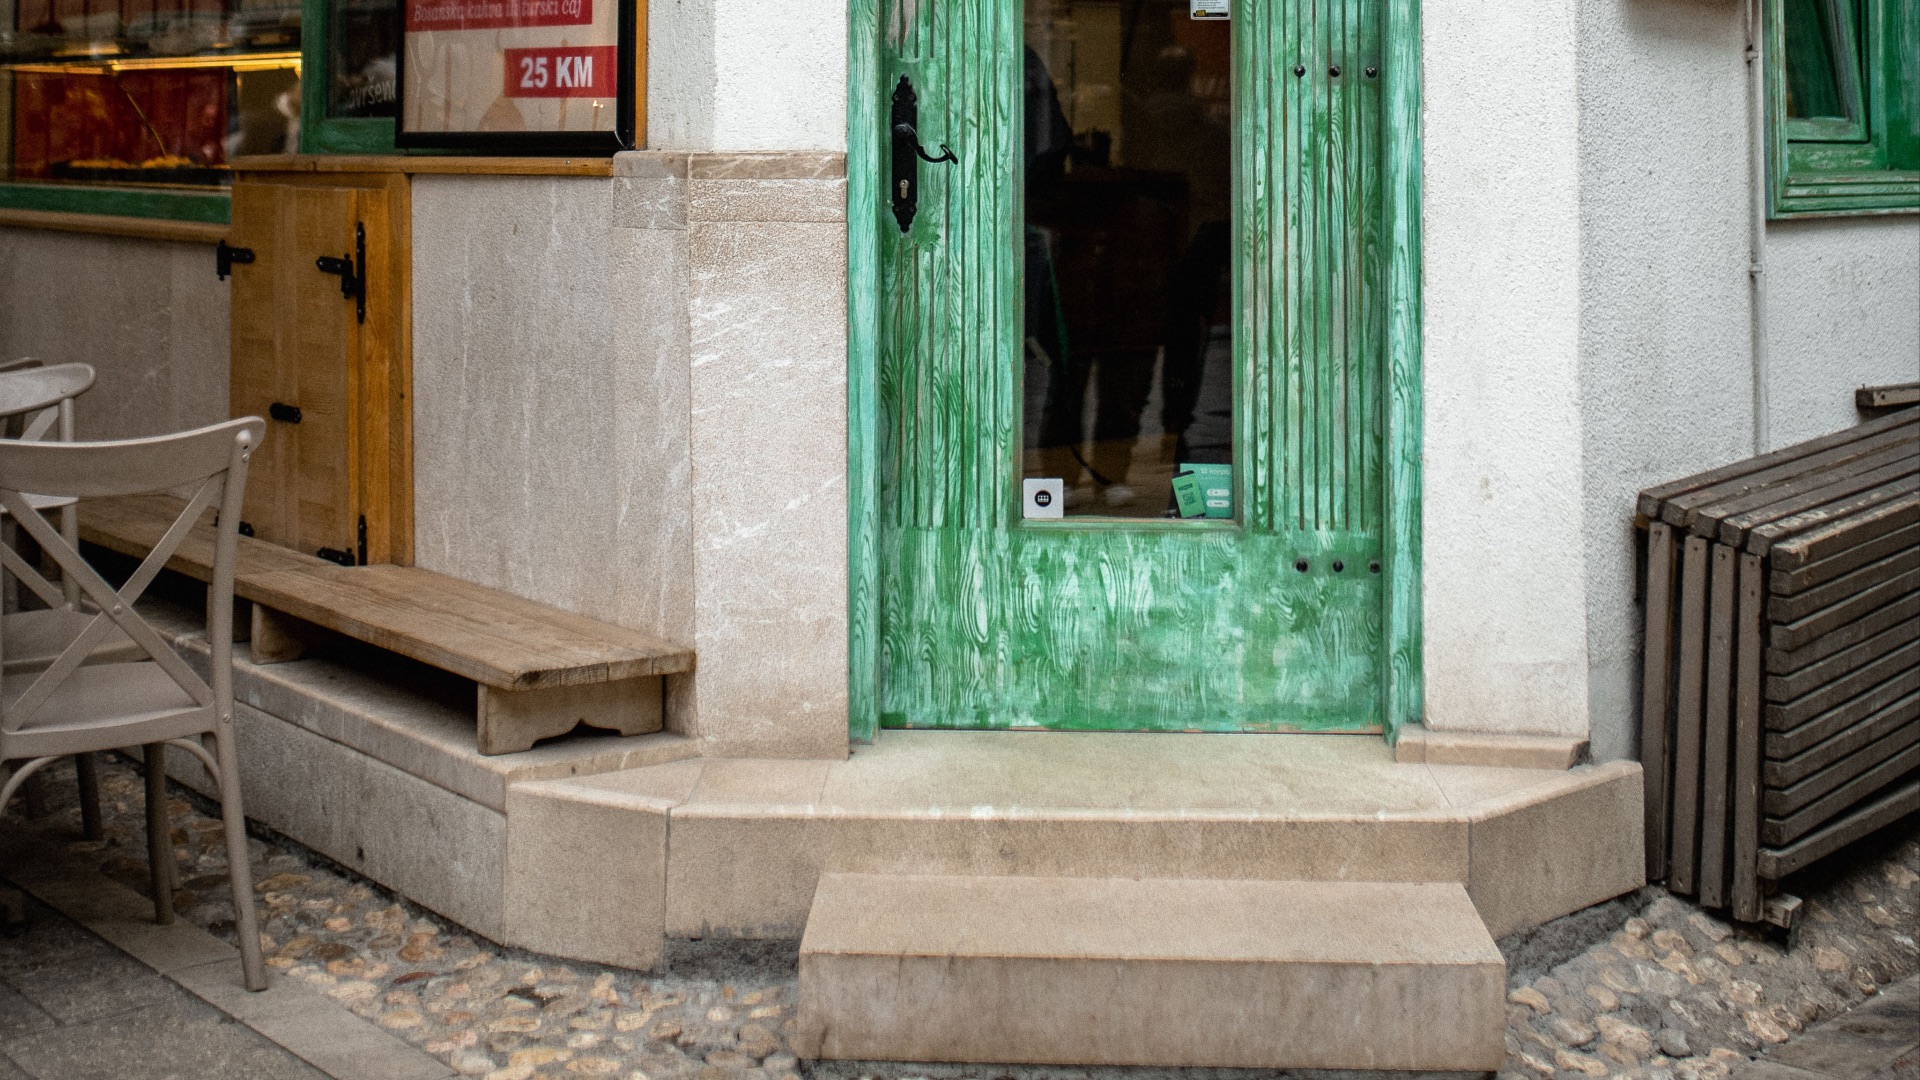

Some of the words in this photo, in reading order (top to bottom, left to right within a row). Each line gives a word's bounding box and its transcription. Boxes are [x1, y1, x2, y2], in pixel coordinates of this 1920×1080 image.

[414, 4, 463, 22] Bosanska
[520, 56, 548, 88] 25
[555, 56, 593, 88] KM
